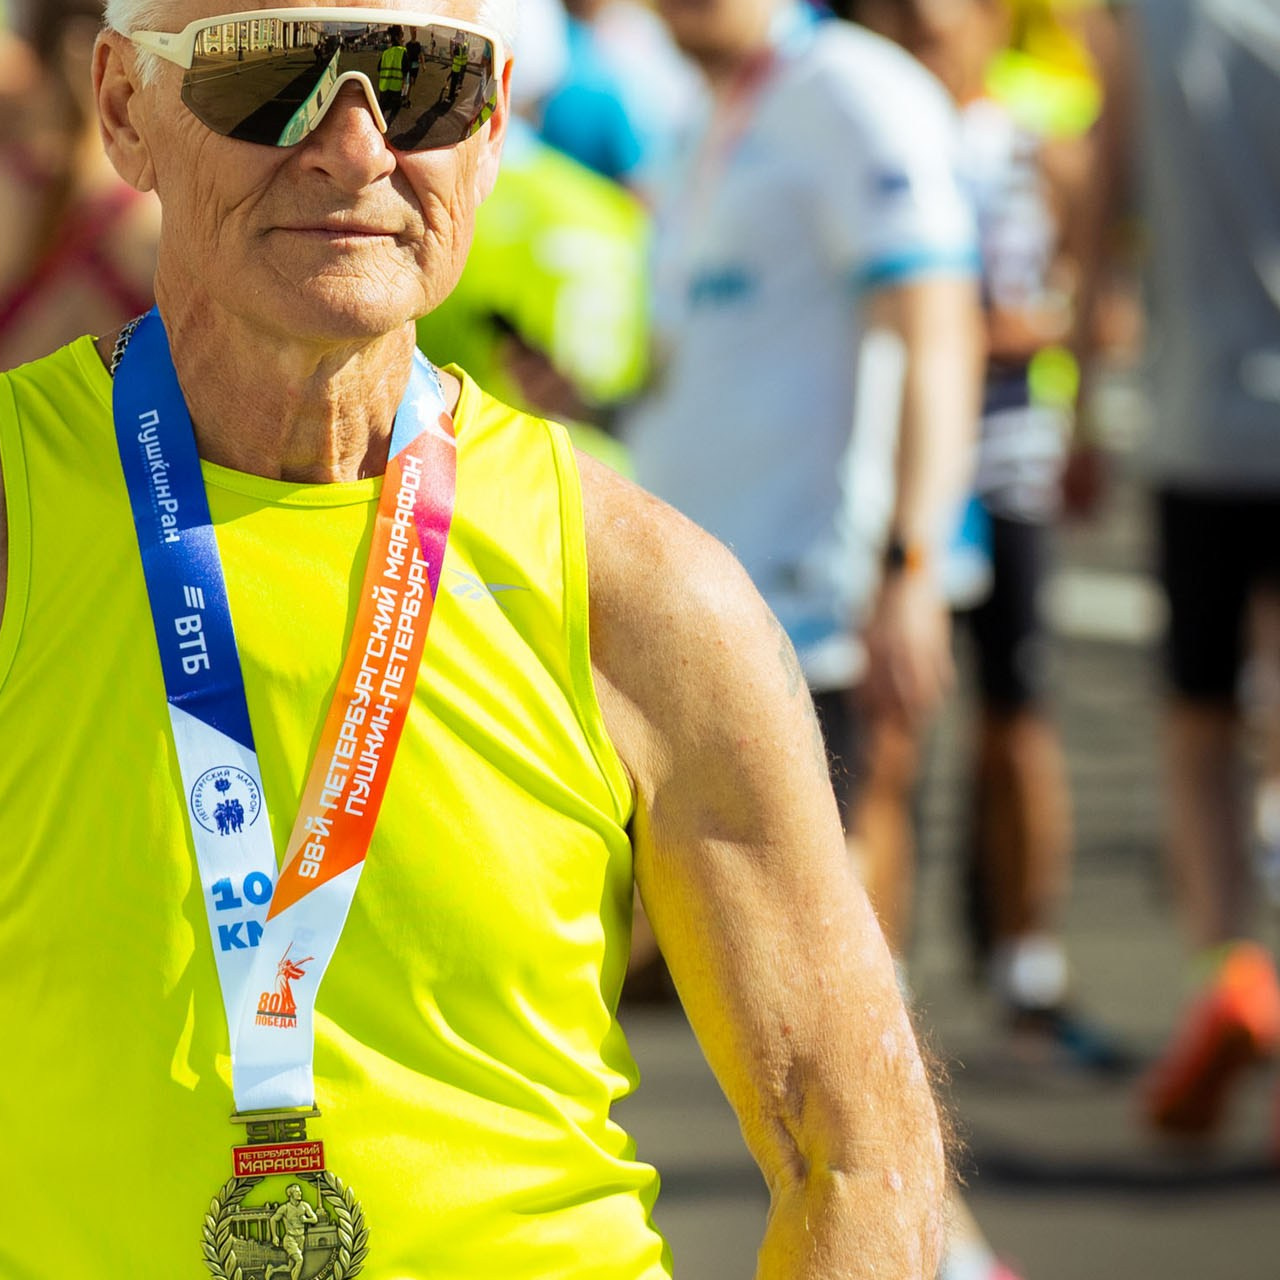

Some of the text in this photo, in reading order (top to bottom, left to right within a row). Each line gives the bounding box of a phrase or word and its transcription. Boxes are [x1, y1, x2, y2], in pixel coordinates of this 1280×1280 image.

[174, 614, 210, 675] ВТБ
[298, 454, 423, 879] 98-Й ПЕТЕРБУРГСКИЙ МАРАФОН
[345, 548, 429, 816] ПУШКИН-ПЕТЕРБУРГ
[195, 769, 257, 821] ПЕТЕРБУРГСКИЙ МАРАФОН
[211, 871, 273, 911] 10
[257, 992, 280, 1011] 80
[255, 1015, 297, 1028] ПОБЕДА!
[246, 1118, 307, 1145] 98
[238, 1144, 320, 1160] ПЕТЕРБУРГСКИЙ
[240, 1156, 321, 1173] МАРАФОН
